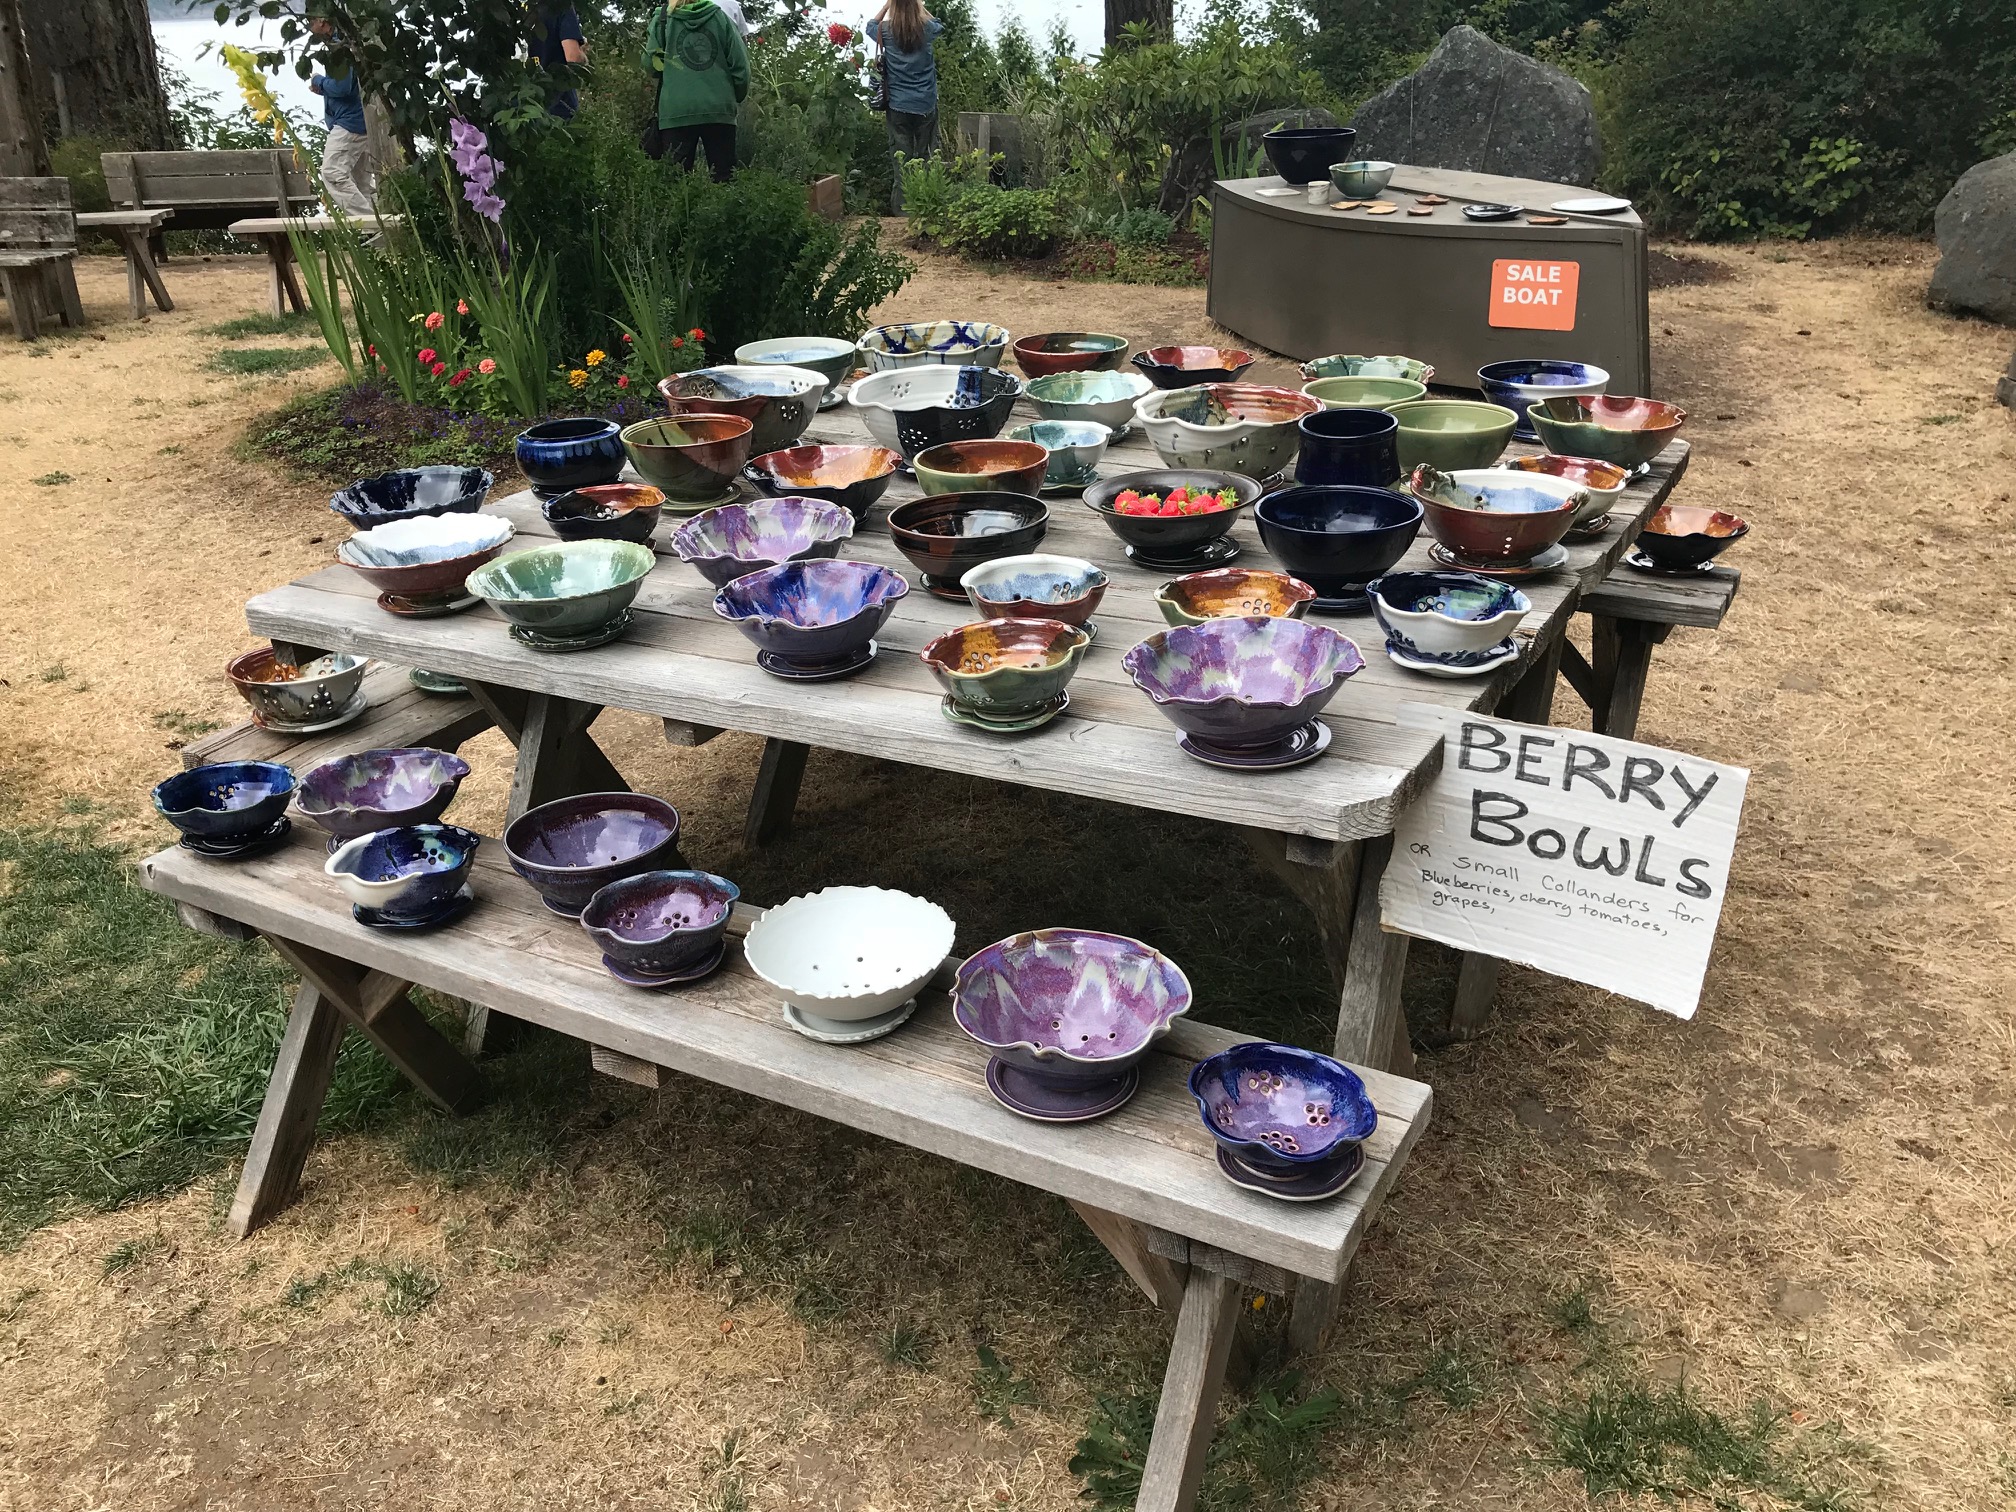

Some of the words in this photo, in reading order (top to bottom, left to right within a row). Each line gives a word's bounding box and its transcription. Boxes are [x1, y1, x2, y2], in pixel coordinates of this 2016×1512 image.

[1503, 286, 1563, 306] BOAT
[1506, 264, 1561, 283] SALE
[1458, 722, 1719, 828] BERRY
[1470, 788, 1712, 900] BOWLS
[1410, 843, 1431, 857] OR
[1453, 856, 1520, 882] Small
[1541, 875, 1650, 913] Collanders
[1668, 902, 1704, 924] for
[1421, 869, 1515, 903] Blueberries,
[1520, 892, 1572, 918] cherry
[1579, 904, 1668, 936] tomatoes,
[1432, 890, 1496, 914] grapes,
